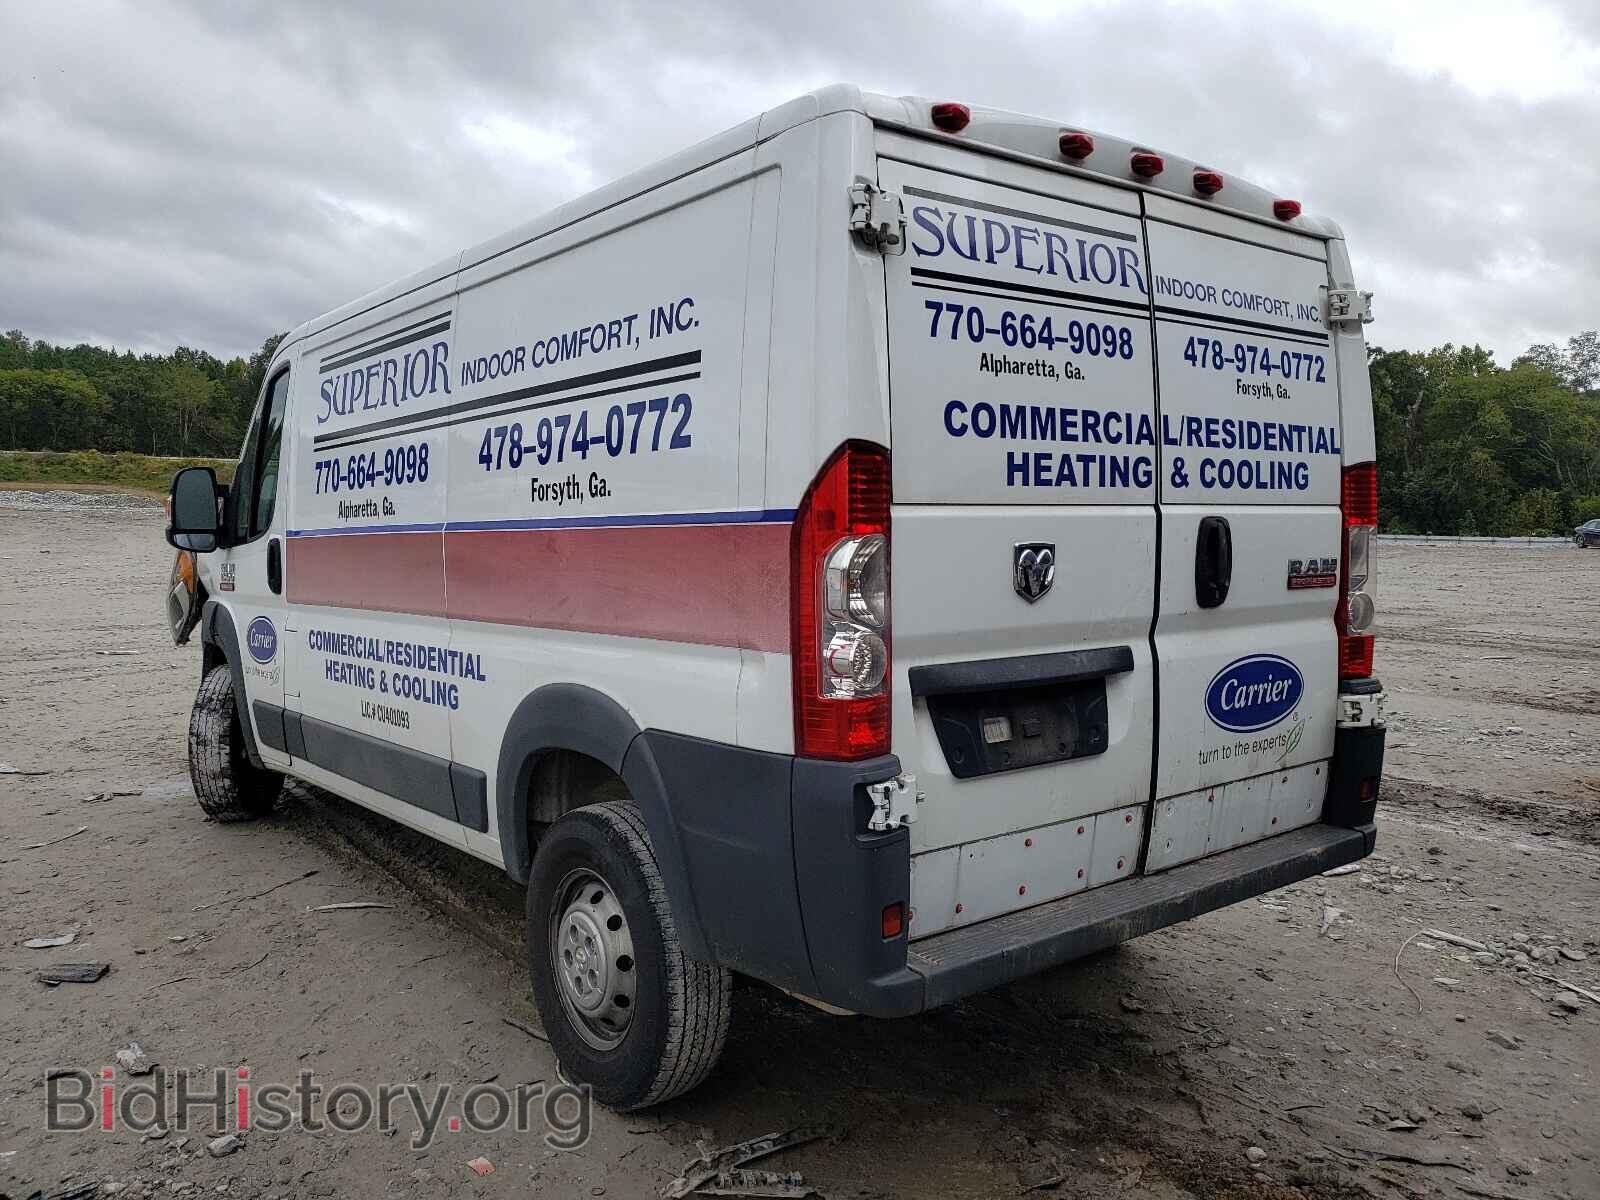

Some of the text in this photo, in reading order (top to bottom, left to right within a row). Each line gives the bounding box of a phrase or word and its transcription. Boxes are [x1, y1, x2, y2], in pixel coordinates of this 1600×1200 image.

[912, 206, 1322, 323] SUPERIOR INDOOR COMFORT, INC.
[925, 300, 1133, 360] 770-664-9098
[317, 297, 700, 424] SUPERIOR INDOOR COMFORT, INC.
[979, 353, 1085, 382] Alpharetta, Ga.
[1184, 336, 1326, 383] 478-974-0772
[1236, 378, 1291, 400] Forsyth, Ga.
[479, 393, 692, 471] 478-974-0772
[315, 443, 429, 494] 770-664-9098
[531, 472, 611, 506] Forsyth, Ga.
[1006, 451, 1309, 491] HEATING & COOLING
[338, 496, 395, 522] Alpharetta, Ga.
[250, 627, 274, 649] Carrier
[308, 629, 487, 682] COMMERCIAL/RESIDENTIAL
[325, 659, 459, 710] HEATING & COOLING
[1221, 674, 1292, 711] Carrier
[1198, 733, 1287, 765] turn to the experts
